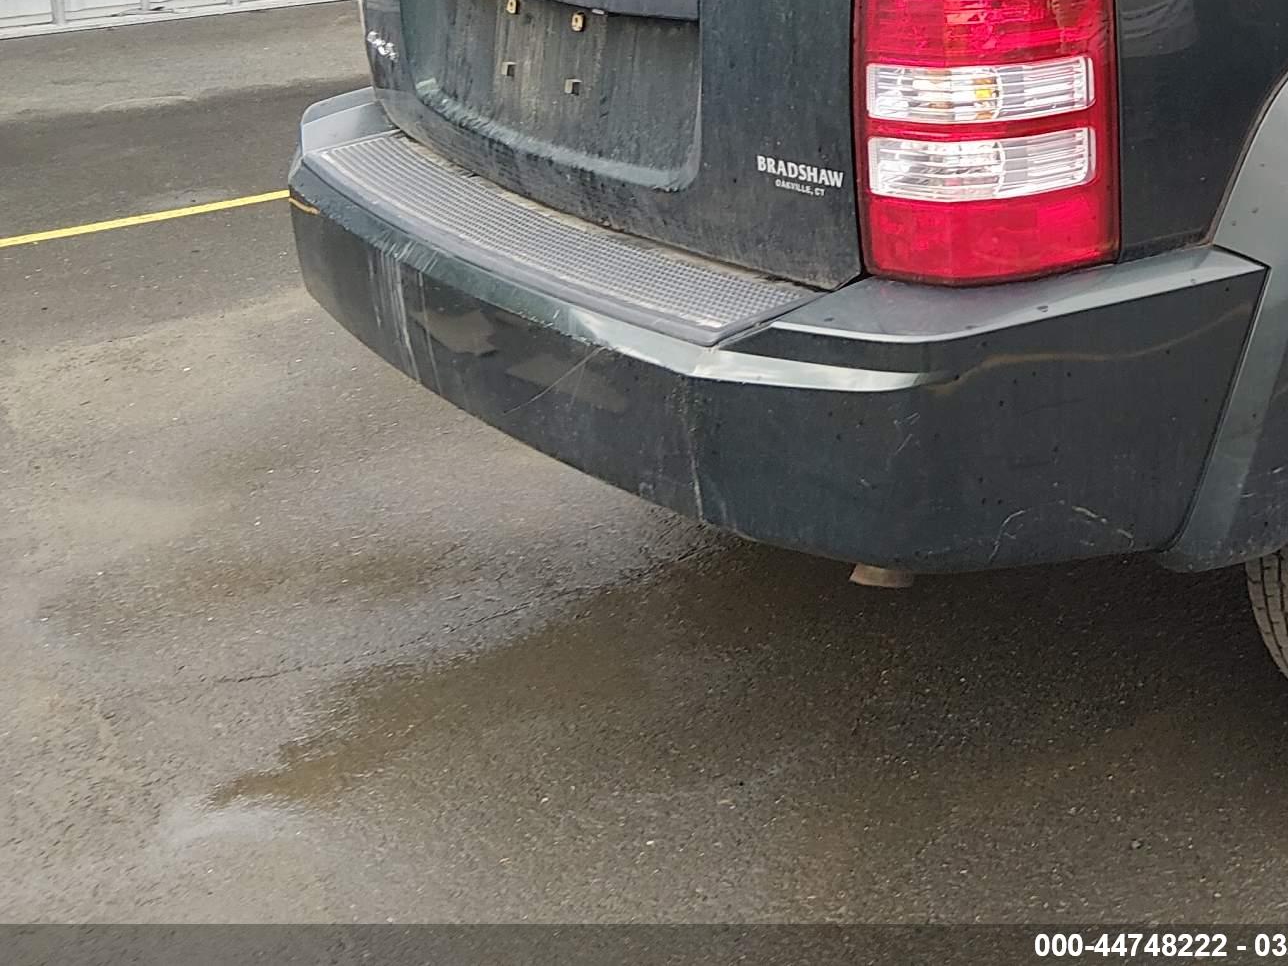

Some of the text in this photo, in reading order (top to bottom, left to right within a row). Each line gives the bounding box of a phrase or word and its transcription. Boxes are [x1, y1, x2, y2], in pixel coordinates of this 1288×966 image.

[756, 155, 844, 188] BRADSHAW
[775, 179, 825, 197] OAKVILLE, CT
